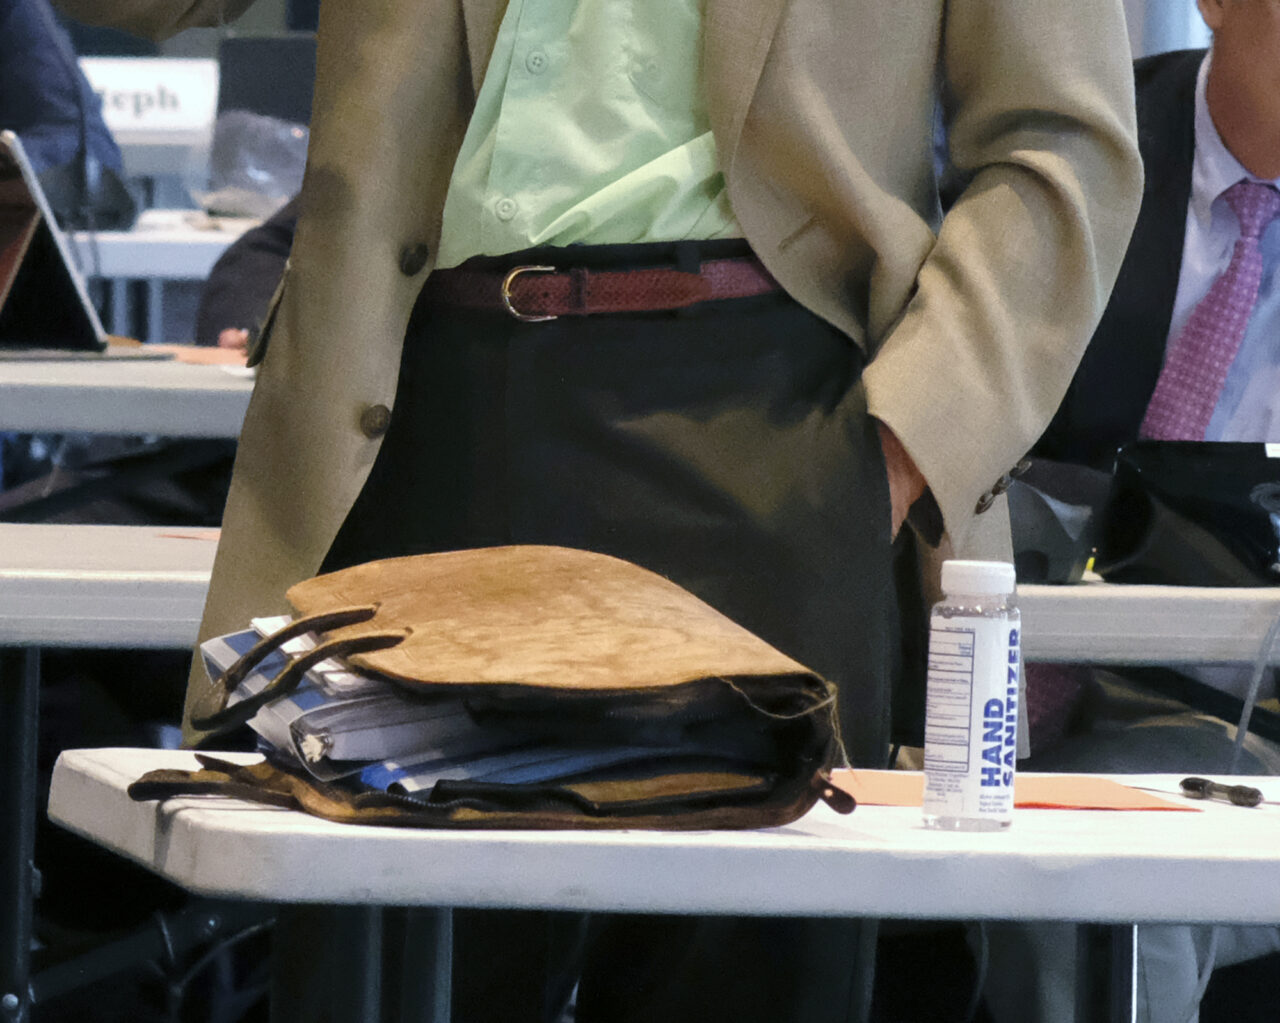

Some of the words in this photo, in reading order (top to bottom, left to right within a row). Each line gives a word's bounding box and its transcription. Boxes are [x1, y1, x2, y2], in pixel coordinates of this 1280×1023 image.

[99, 85, 180, 118] eph
[980, 697, 1005, 788] HAND
[1003, 629, 1019, 787] SANITIZER
